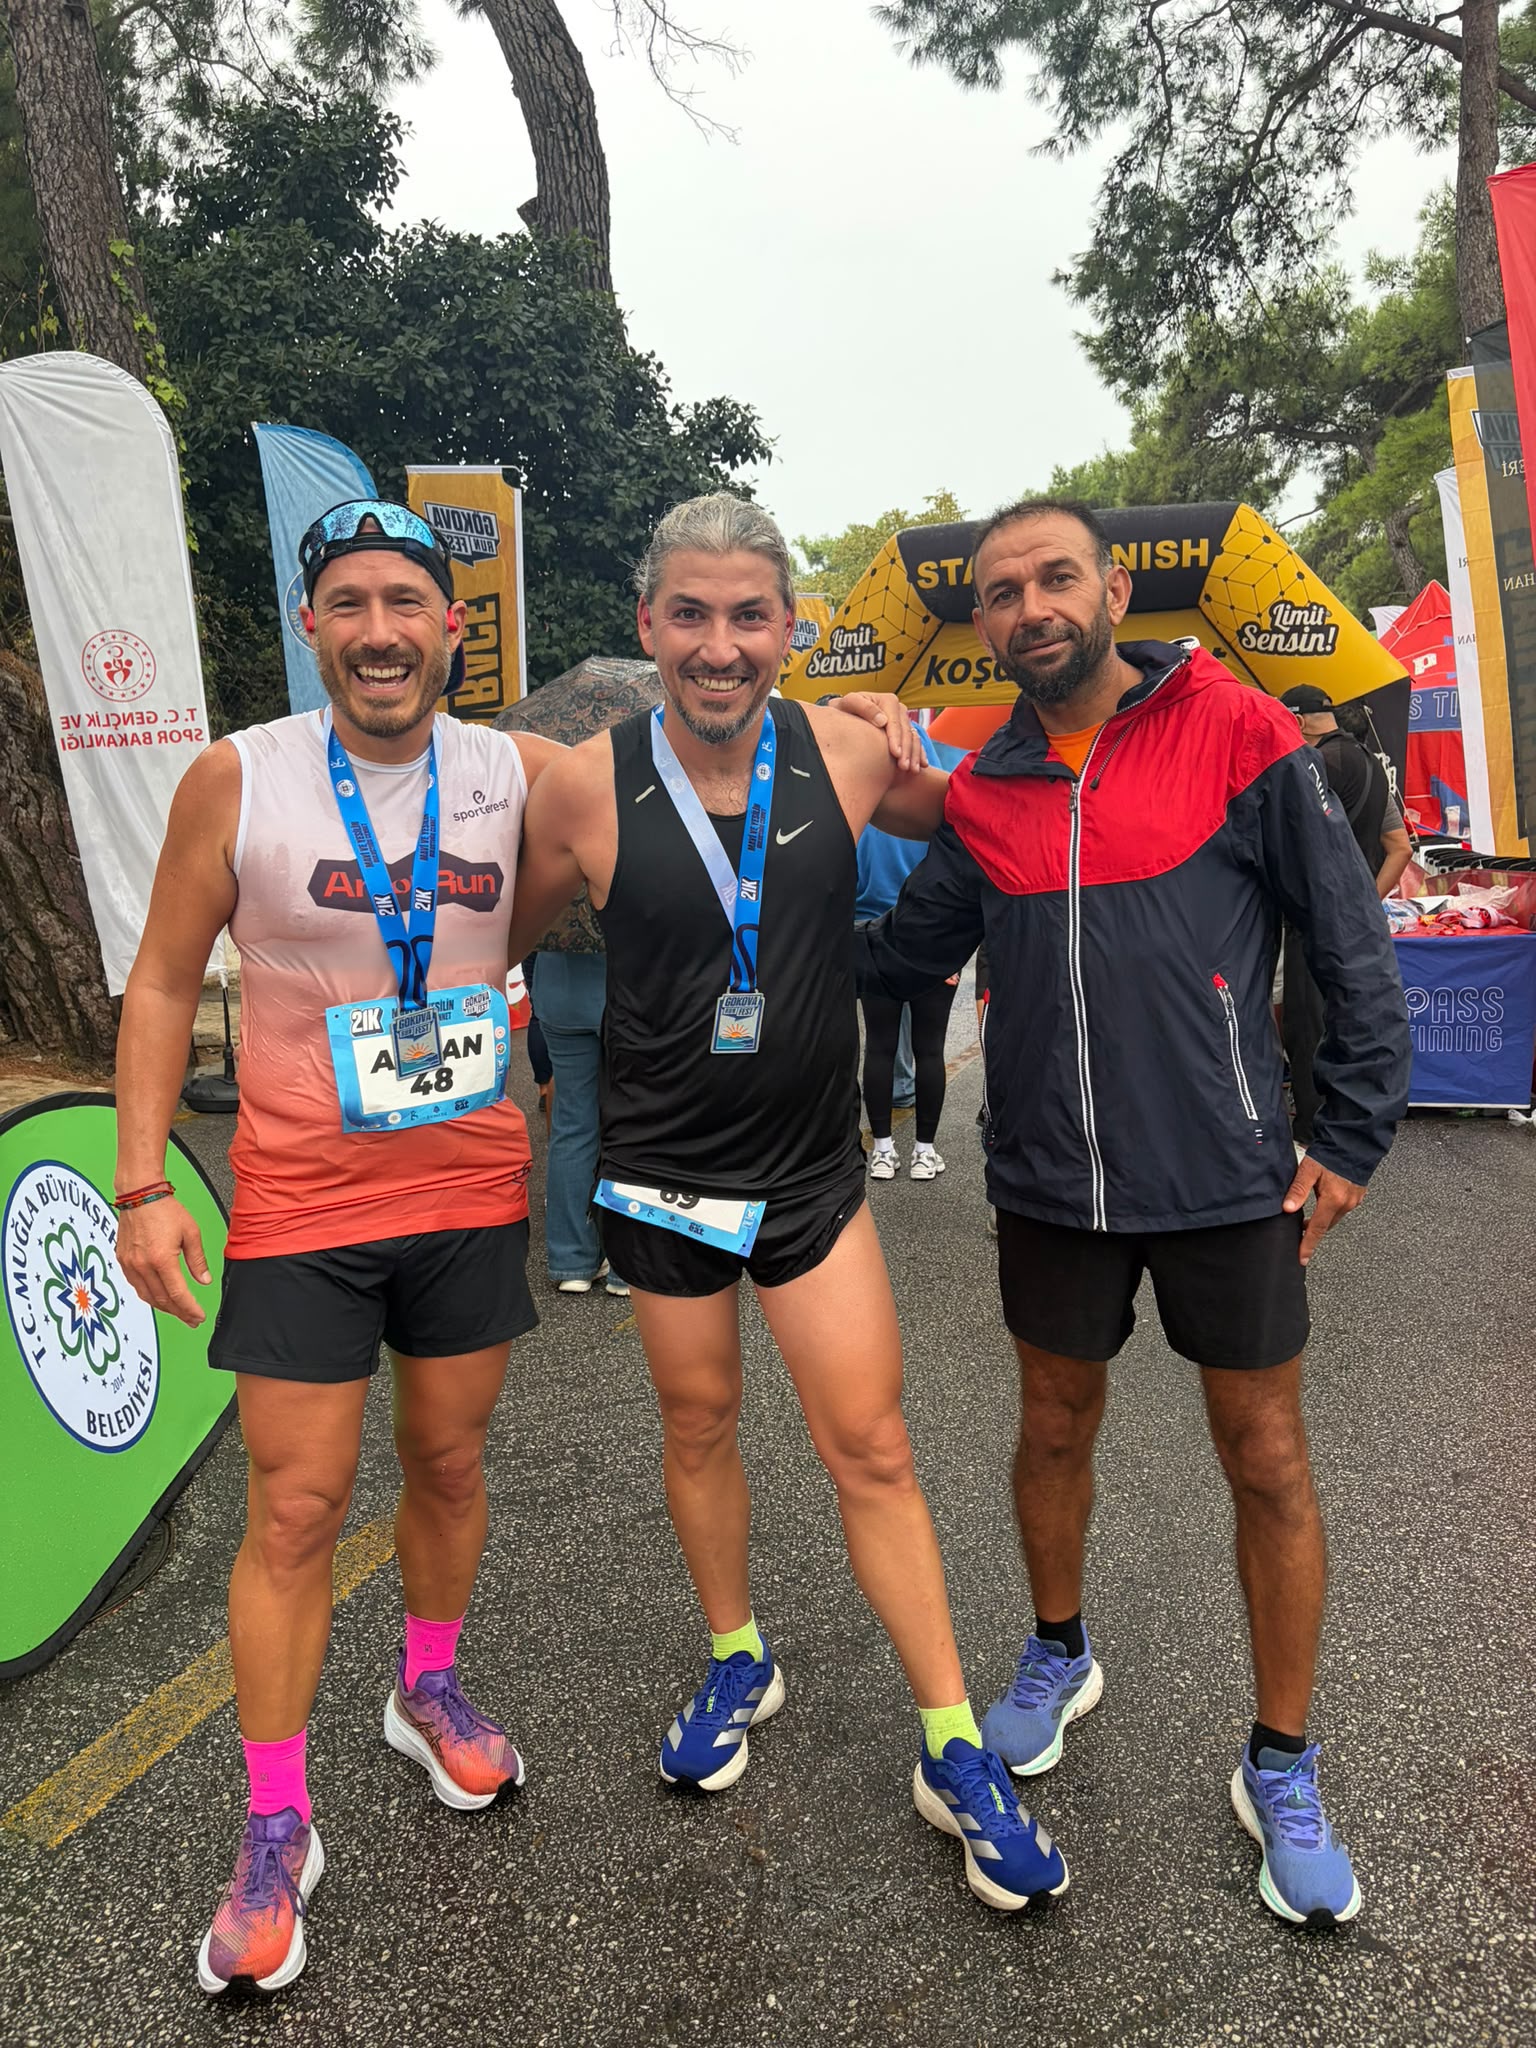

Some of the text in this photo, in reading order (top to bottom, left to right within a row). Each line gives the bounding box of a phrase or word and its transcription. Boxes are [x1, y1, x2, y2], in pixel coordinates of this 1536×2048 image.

[1111, 538, 1209, 571] NISH
[1272, 603, 1326, 627] Limit
[832, 625, 871, 655] Limit
[1240, 624, 1337, 653] Sensin!
[807, 644, 884, 676] Sensin!
[453, 798, 510, 823] sporterest
[414, 889, 433, 912] 21K
[741, 879, 759, 901] 21K
[1404, 986, 1504, 1024] PASS
[351, 1007, 383, 1034] 21K
[370, 1033, 483, 1075] AAN
[410, 1067, 454, 1096] 48
[36, 1174, 117, 1248] BÜYÜKŞEH
[86, 1349, 153, 1438] BELEDİYESİ
[111, 1373, 126, 1394] 2014
